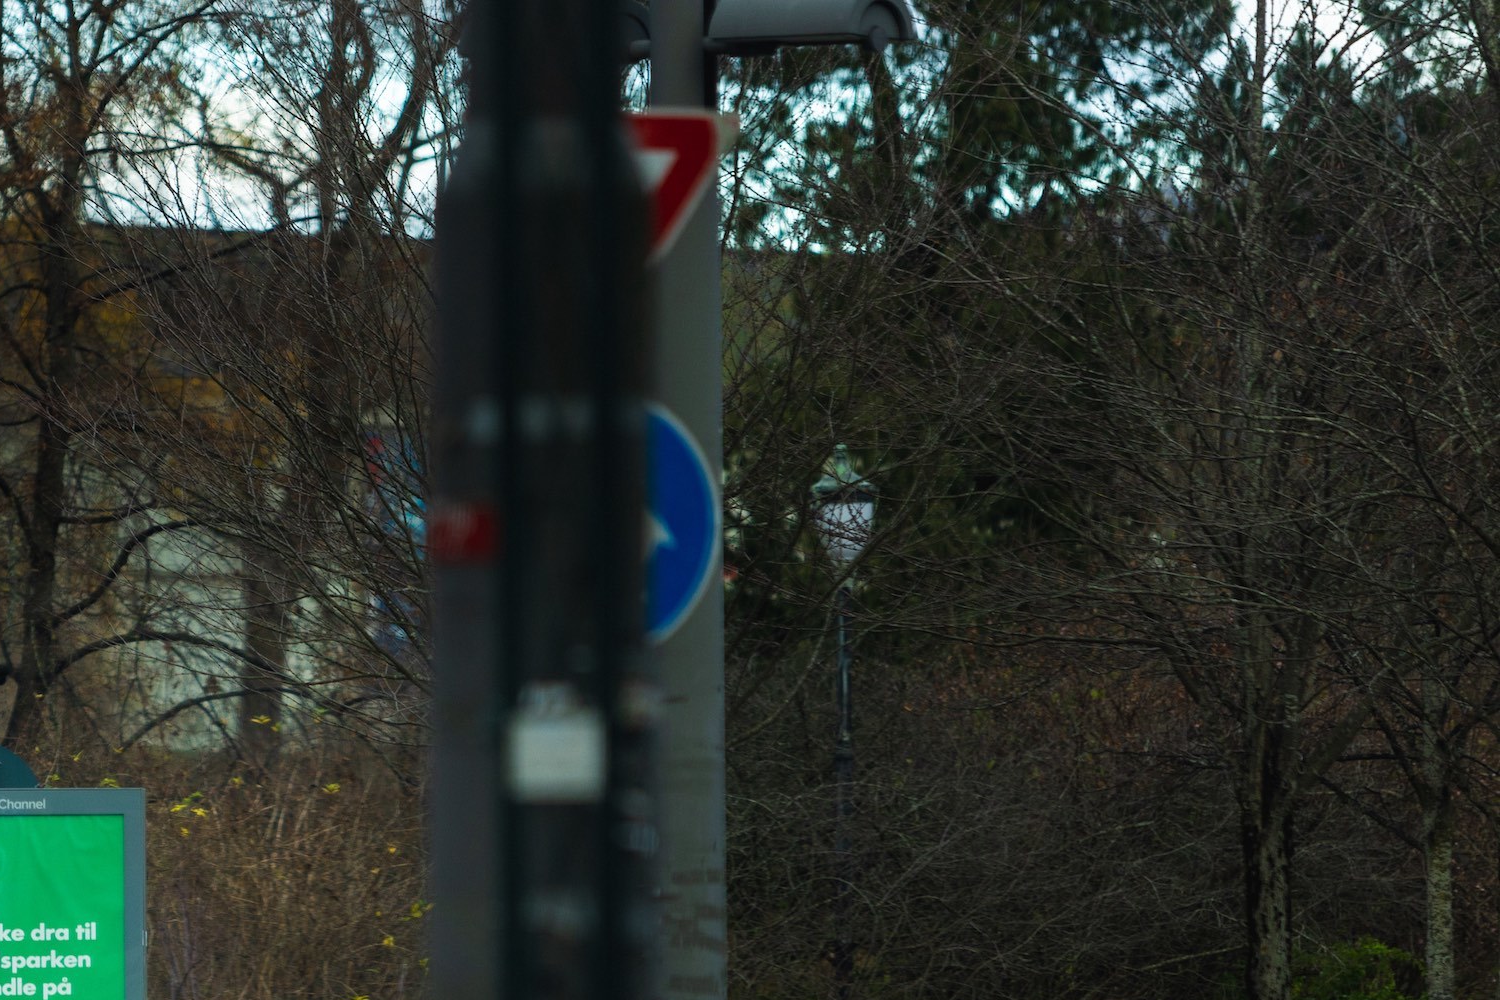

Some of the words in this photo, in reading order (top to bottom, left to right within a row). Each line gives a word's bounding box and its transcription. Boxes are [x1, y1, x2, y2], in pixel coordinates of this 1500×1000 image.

[31, 922, 69, 941] dra
[75, 922, 97, 940] til
[43, 977, 72, 1000] på
